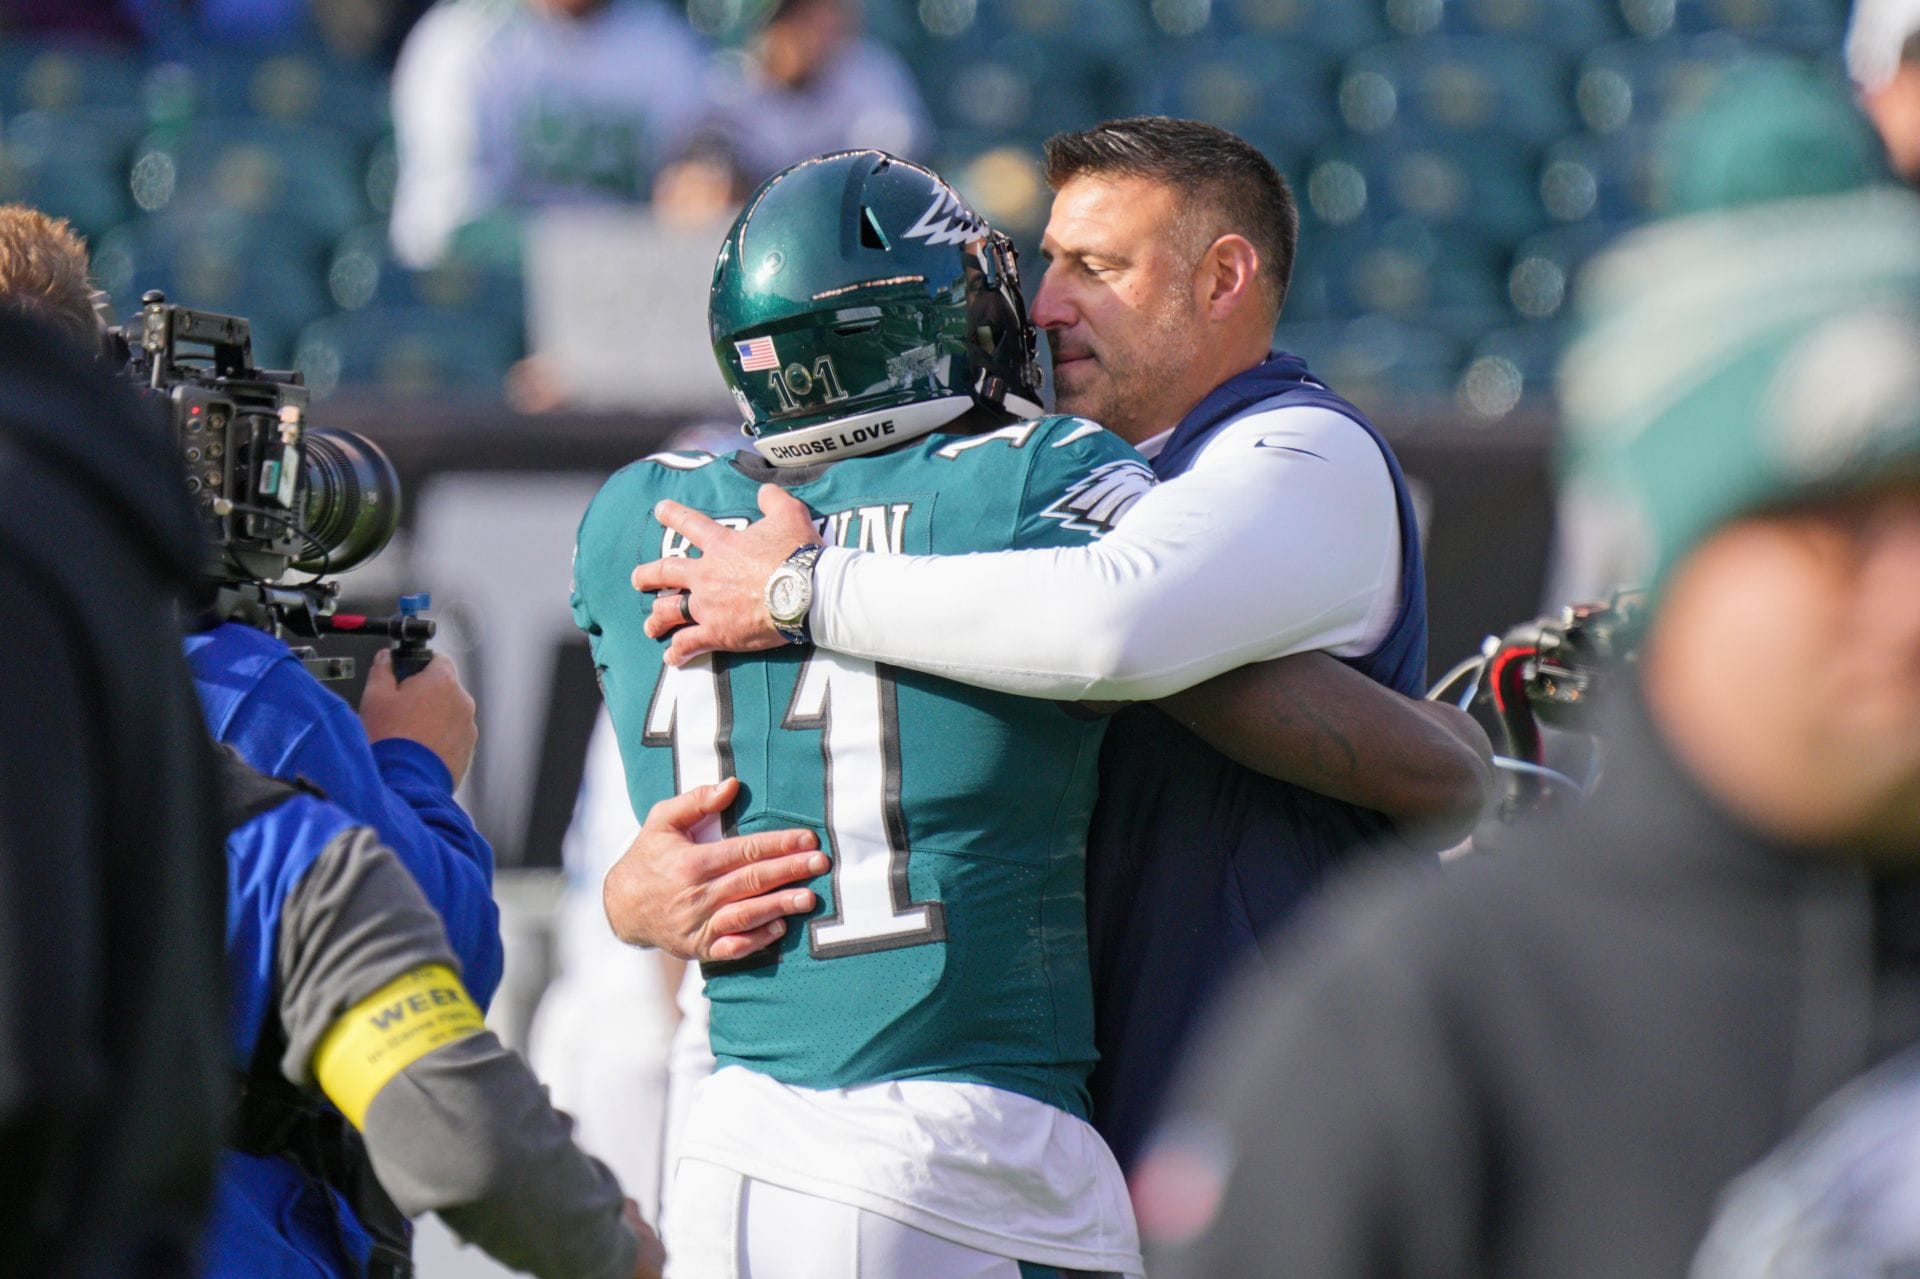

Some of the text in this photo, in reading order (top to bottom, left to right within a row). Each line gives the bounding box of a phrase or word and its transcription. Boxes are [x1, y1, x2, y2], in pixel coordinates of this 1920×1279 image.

[771, 420, 896, 460] CHOOSE LOVE
[641, 649, 947, 960] 11
